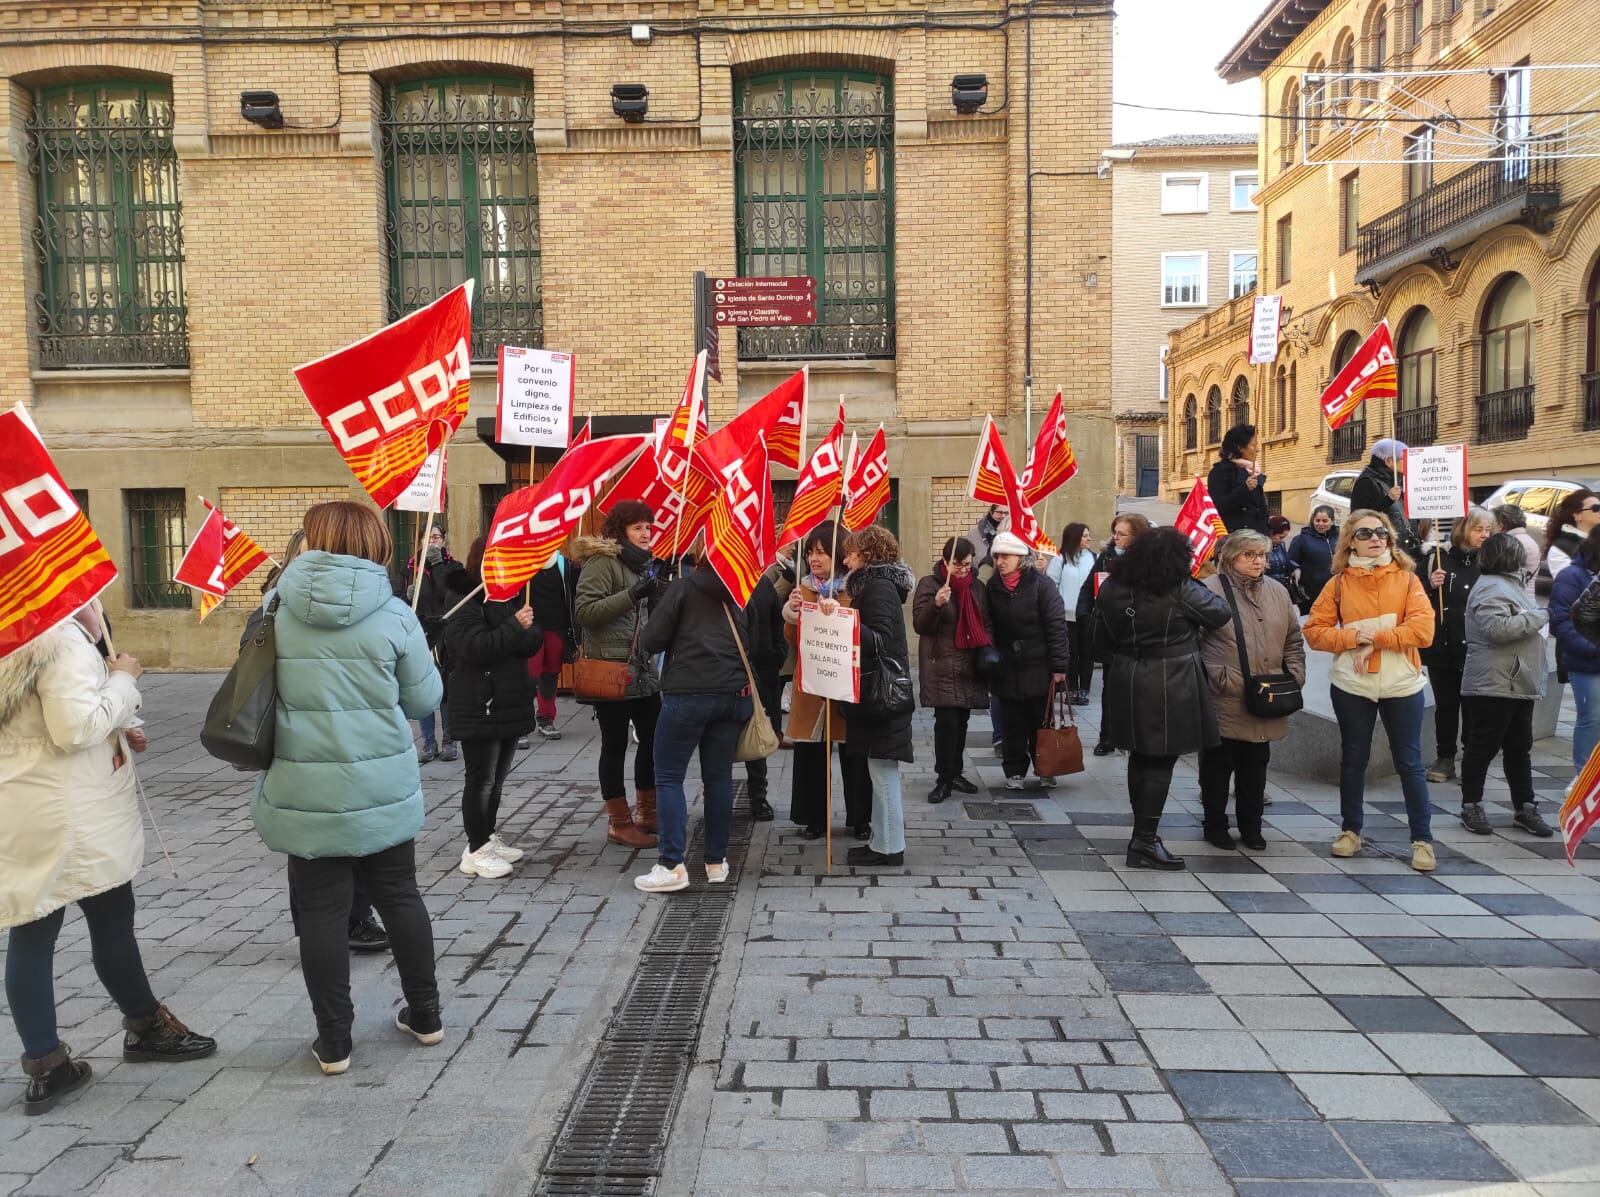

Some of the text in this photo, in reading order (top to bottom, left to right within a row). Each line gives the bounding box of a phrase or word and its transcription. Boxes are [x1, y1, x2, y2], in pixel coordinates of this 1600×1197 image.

[727, 280, 754, 288] Estación
[727, 295, 748, 303] Iglesia
[776, 294, 804, 302] Domingo
[727, 309, 748, 317] Iglesia
[524, 363, 539, 373] Por
[517, 376, 558, 388] convenio
[510, 399, 562, 412] Limpieza de
[513, 411, 559, 425] Edificios y
[518, 424, 553, 435] Locales
[813, 626, 839, 637] POR UN
[804, 639, 848, 653] INCREMENTO
[809, 653, 842, 666] SALARIAL
[816, 668, 838, 678] DIGNO
